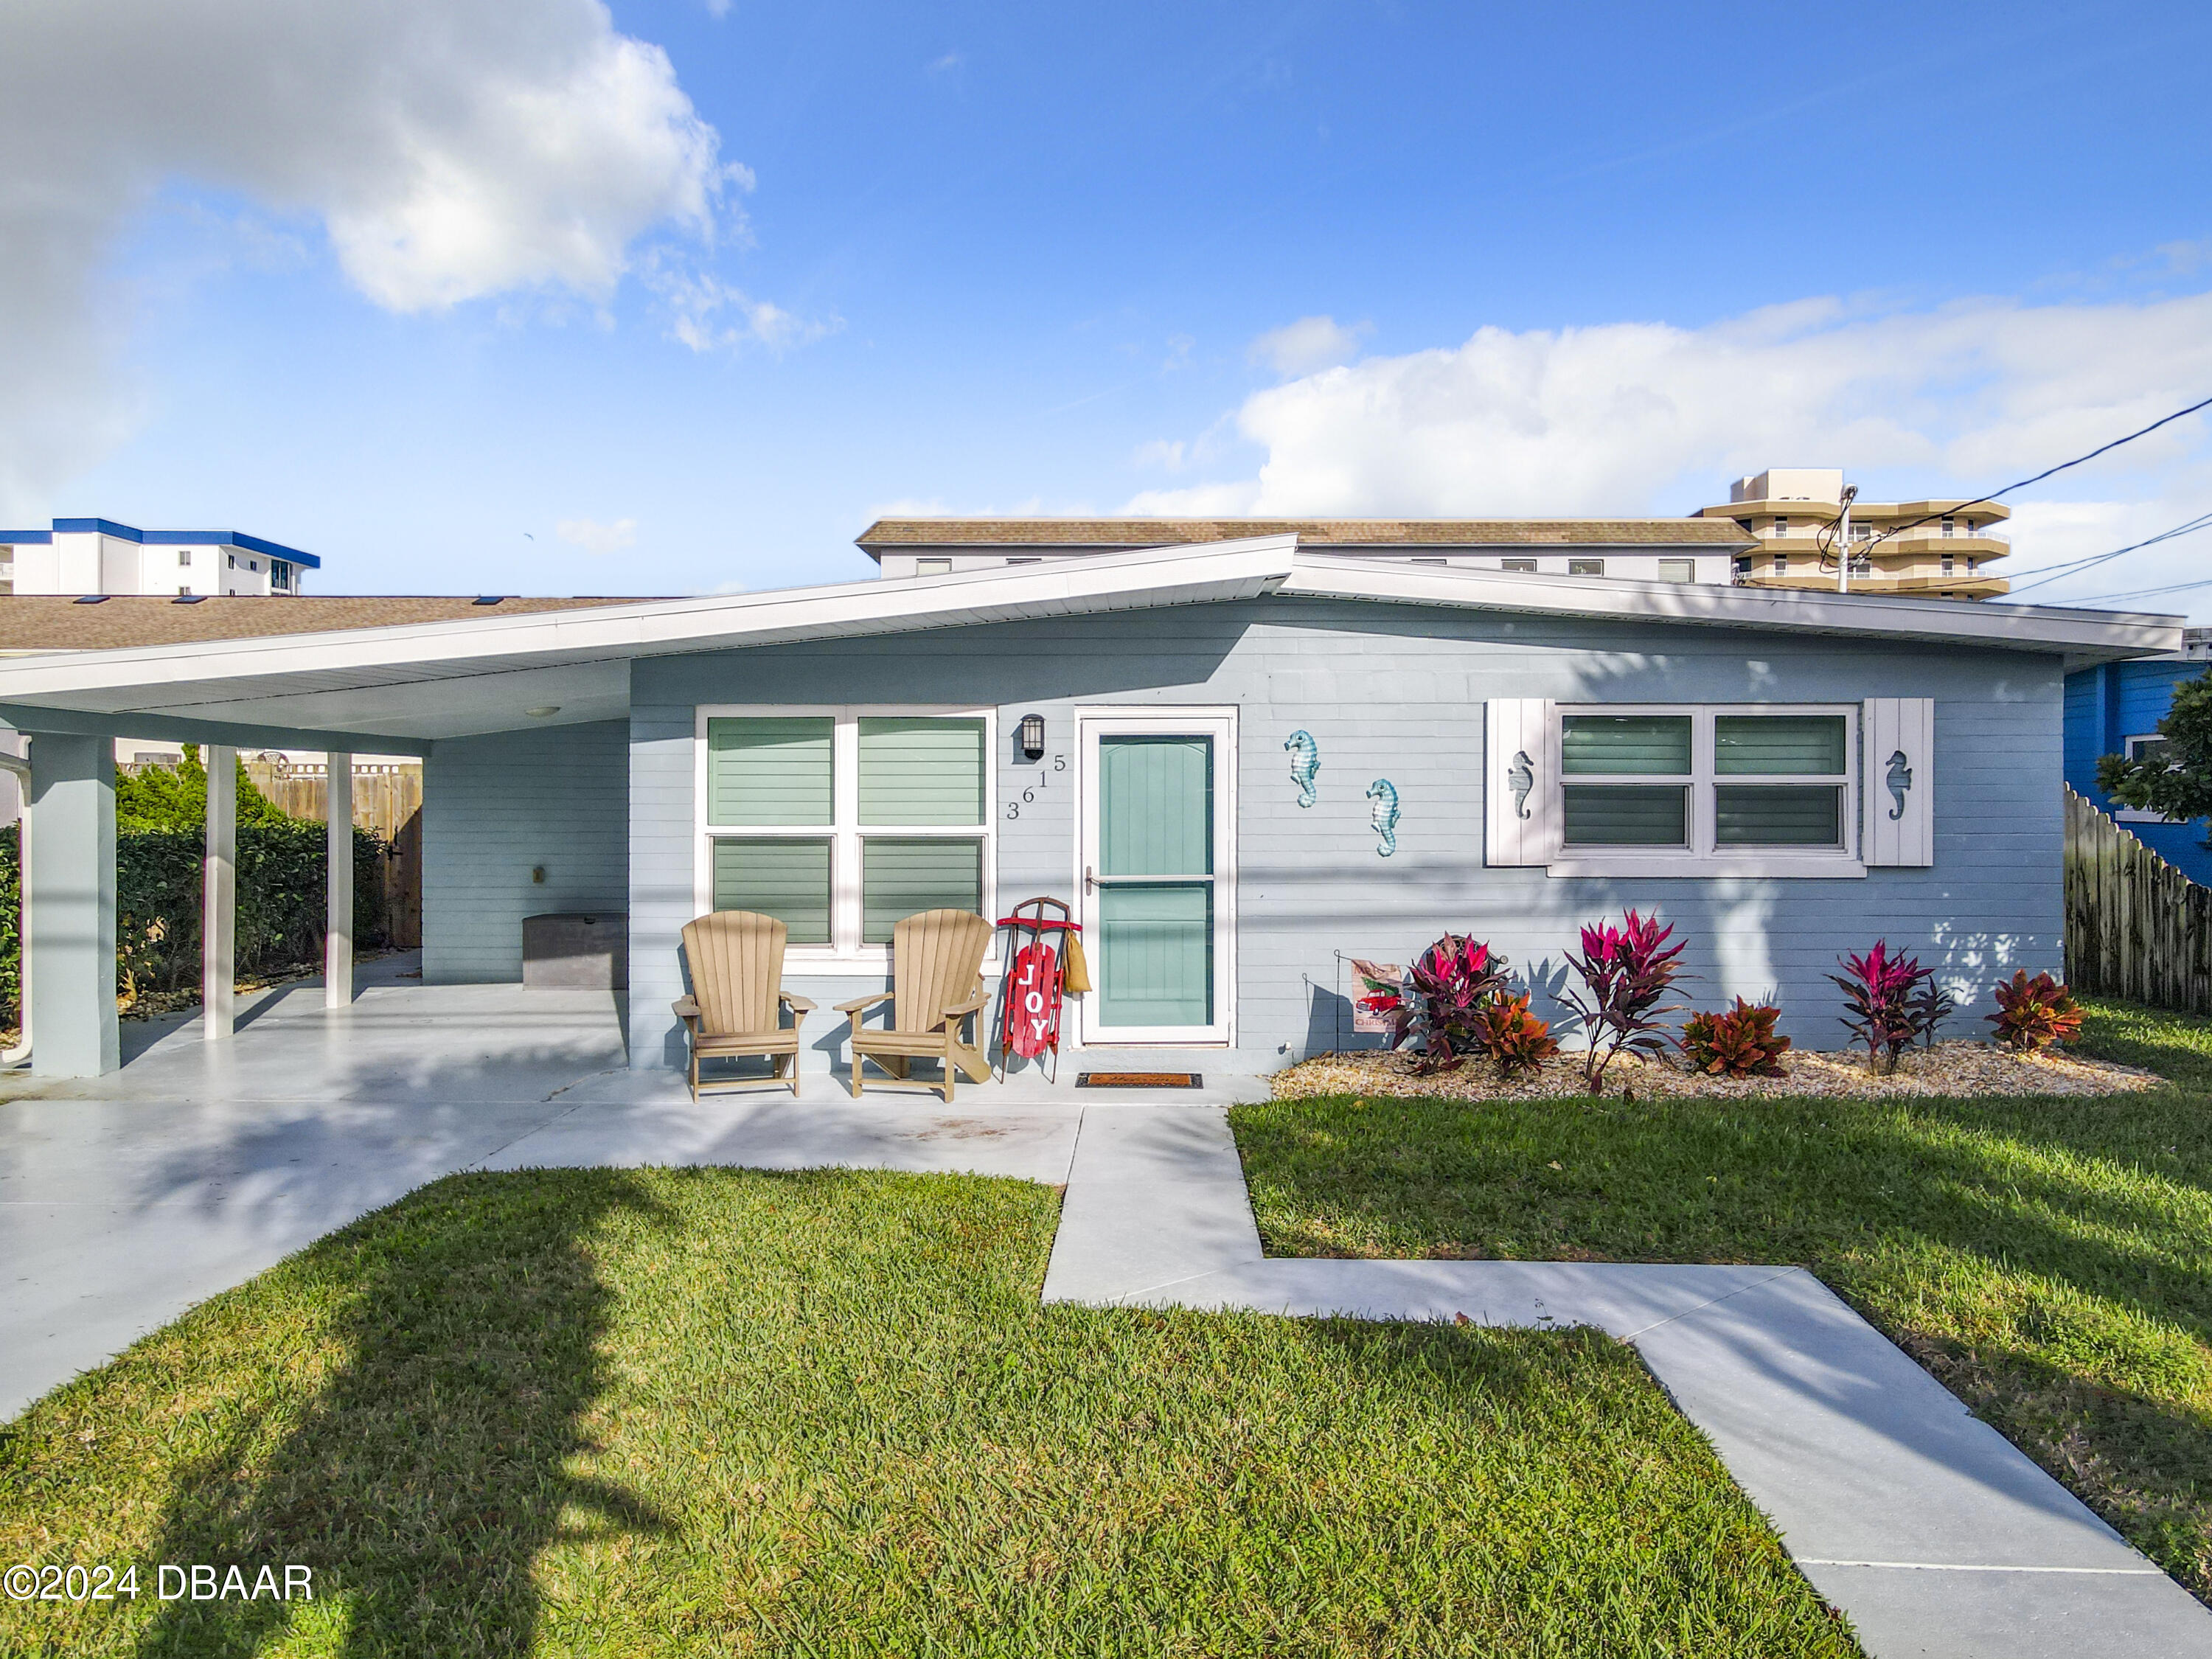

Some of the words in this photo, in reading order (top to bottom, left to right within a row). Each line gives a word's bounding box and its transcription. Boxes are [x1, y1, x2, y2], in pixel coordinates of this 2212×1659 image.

[1006, 754, 1066, 820] 3615
[1018, 964, 1048, 1040] JOY
[1355, 1018, 1395, 1026] CHRISTM
